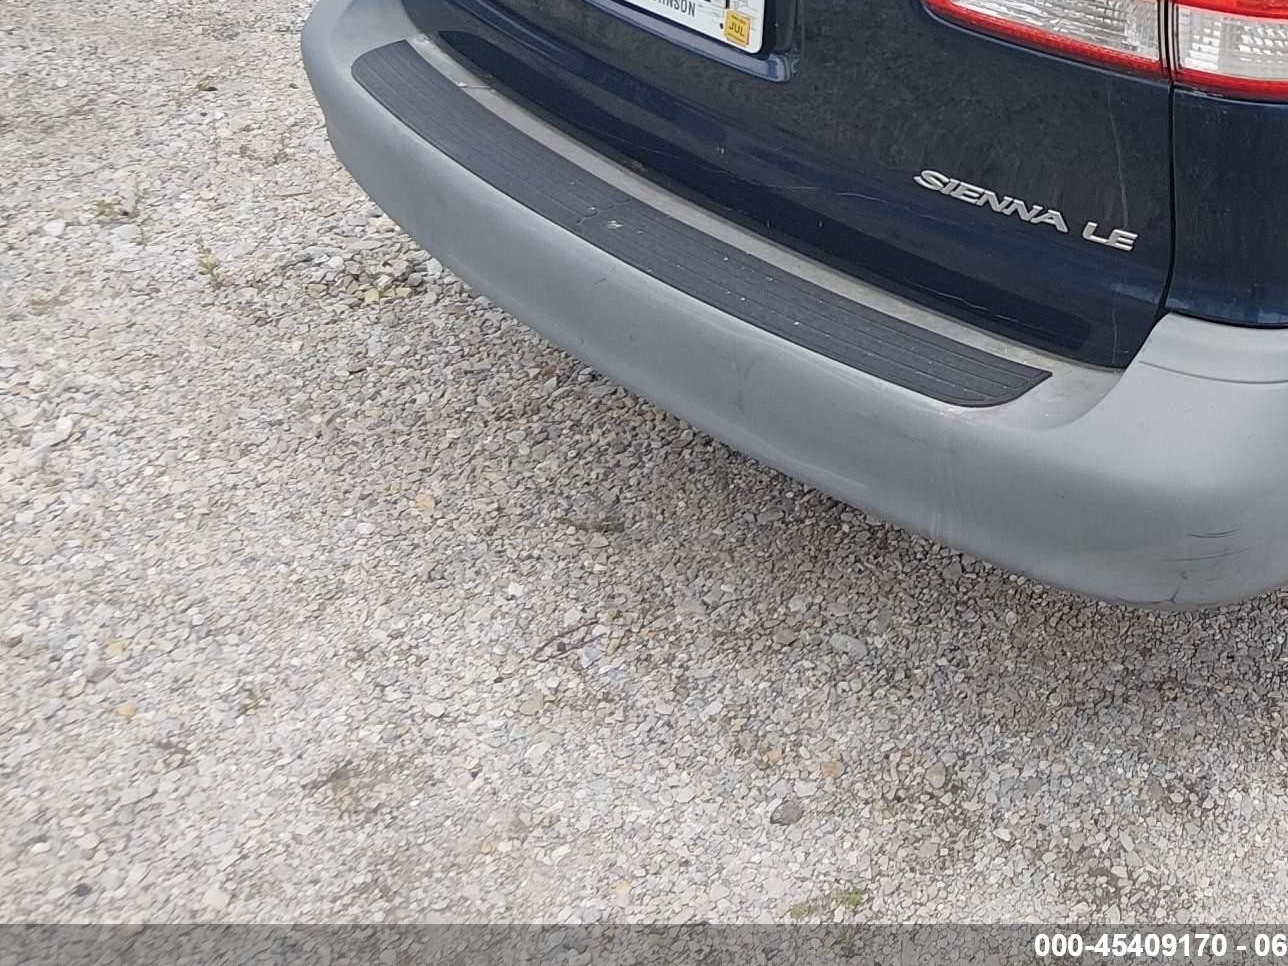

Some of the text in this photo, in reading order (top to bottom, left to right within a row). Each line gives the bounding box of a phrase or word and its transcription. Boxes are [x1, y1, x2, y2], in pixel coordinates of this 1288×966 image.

[729, 21, 745, 37] JUL
[913, 169, 1138, 251] SIENNA LE
